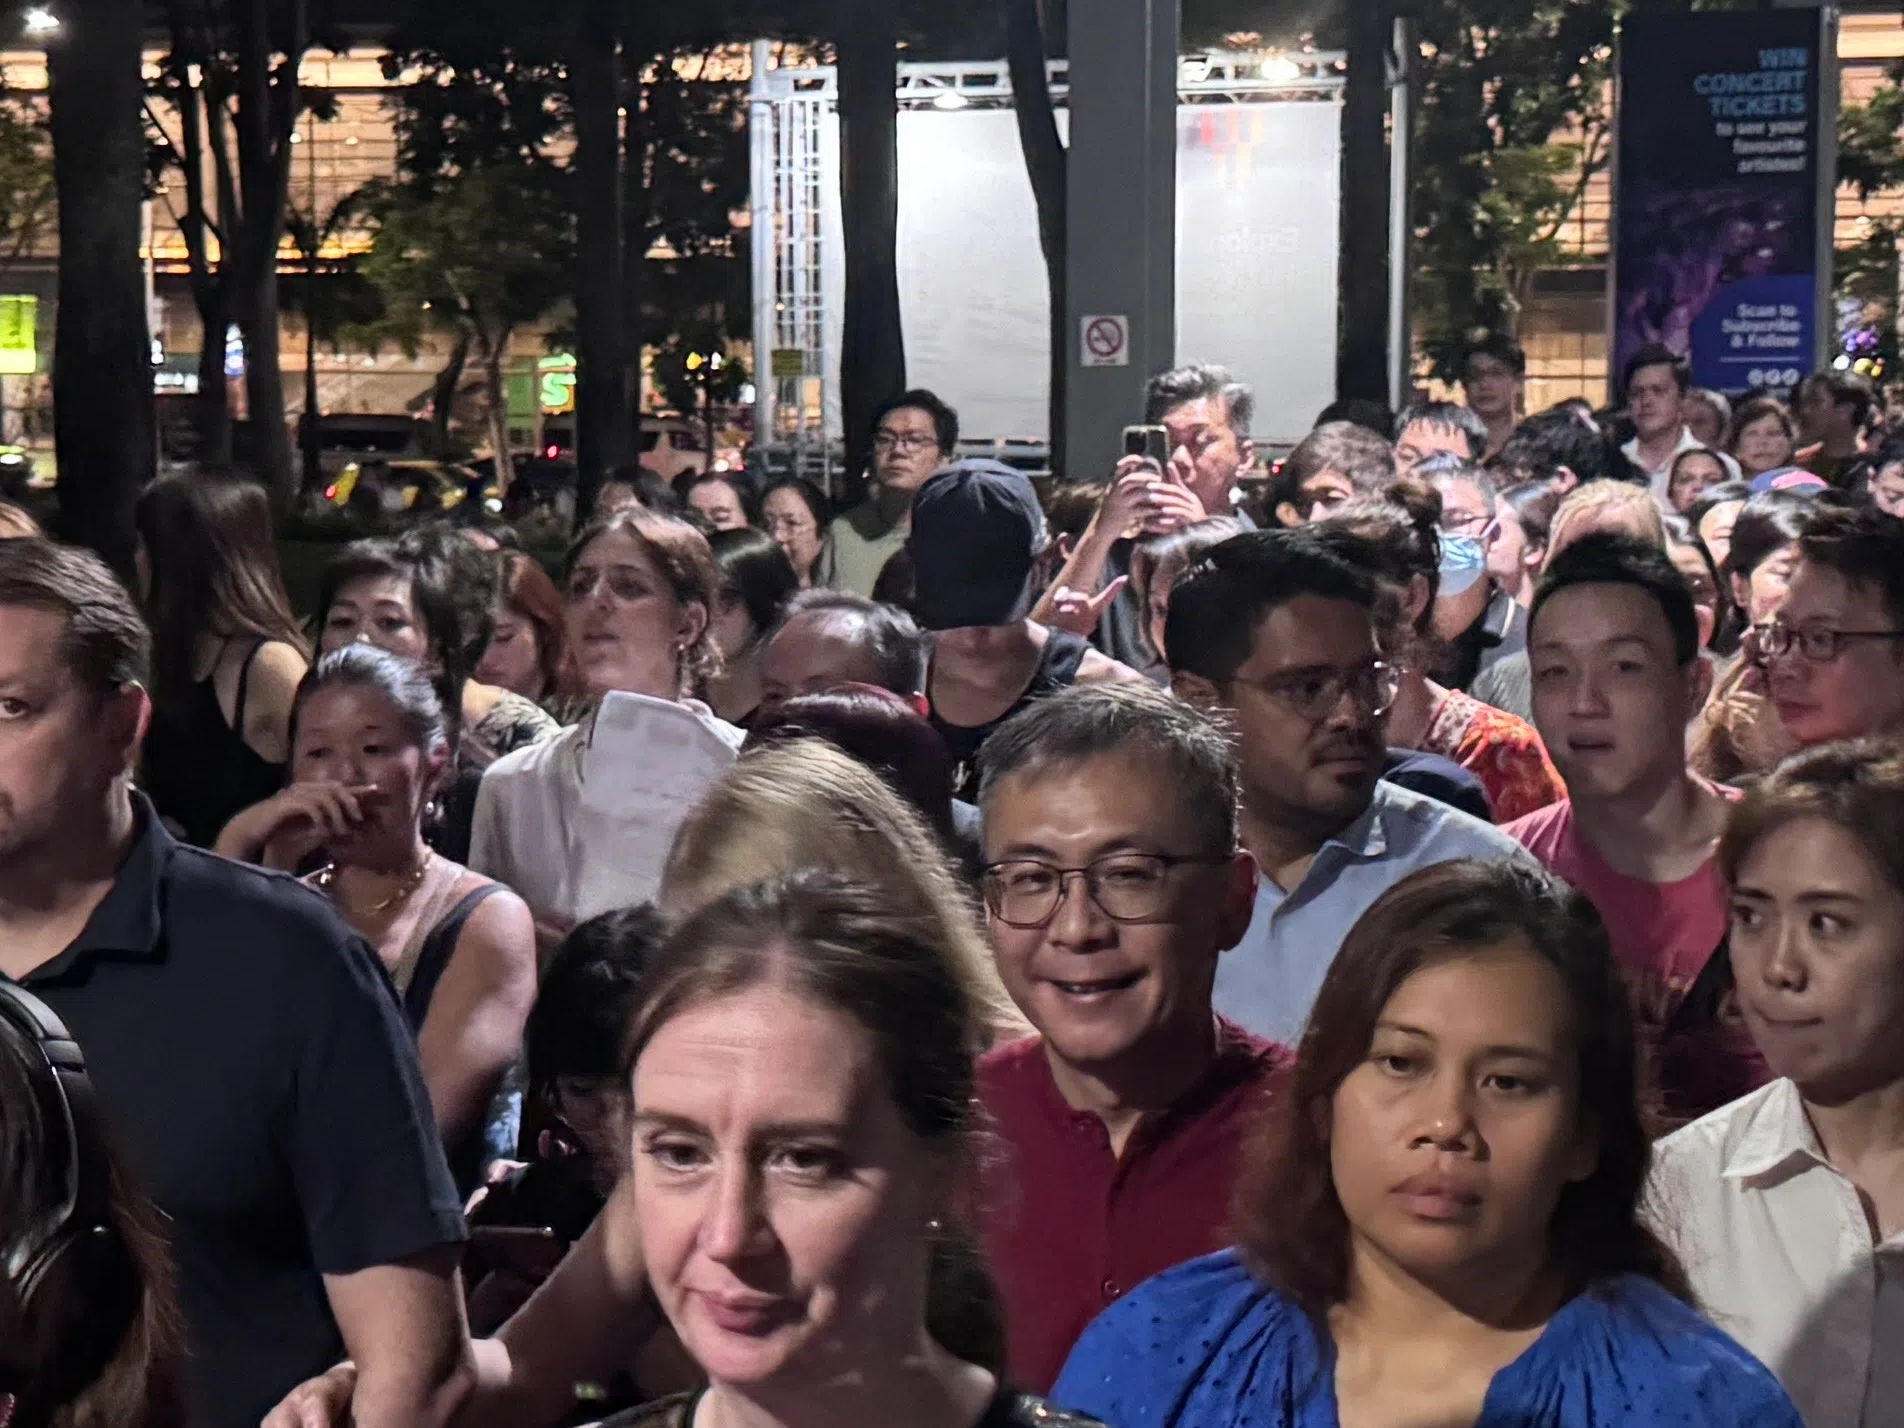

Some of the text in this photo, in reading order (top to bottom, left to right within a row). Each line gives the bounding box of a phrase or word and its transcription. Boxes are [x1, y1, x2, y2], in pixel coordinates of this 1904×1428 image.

[1758, 47, 1808, 69] WIN
[1694, 70, 1808, 95] CONCERT
[1709, 93, 1807, 117] TICKETS
[1736, 303, 1778, 318] Scan
[1721, 318, 1802, 334] Subscribe
[1746, 333, 1801, 349] Follow
